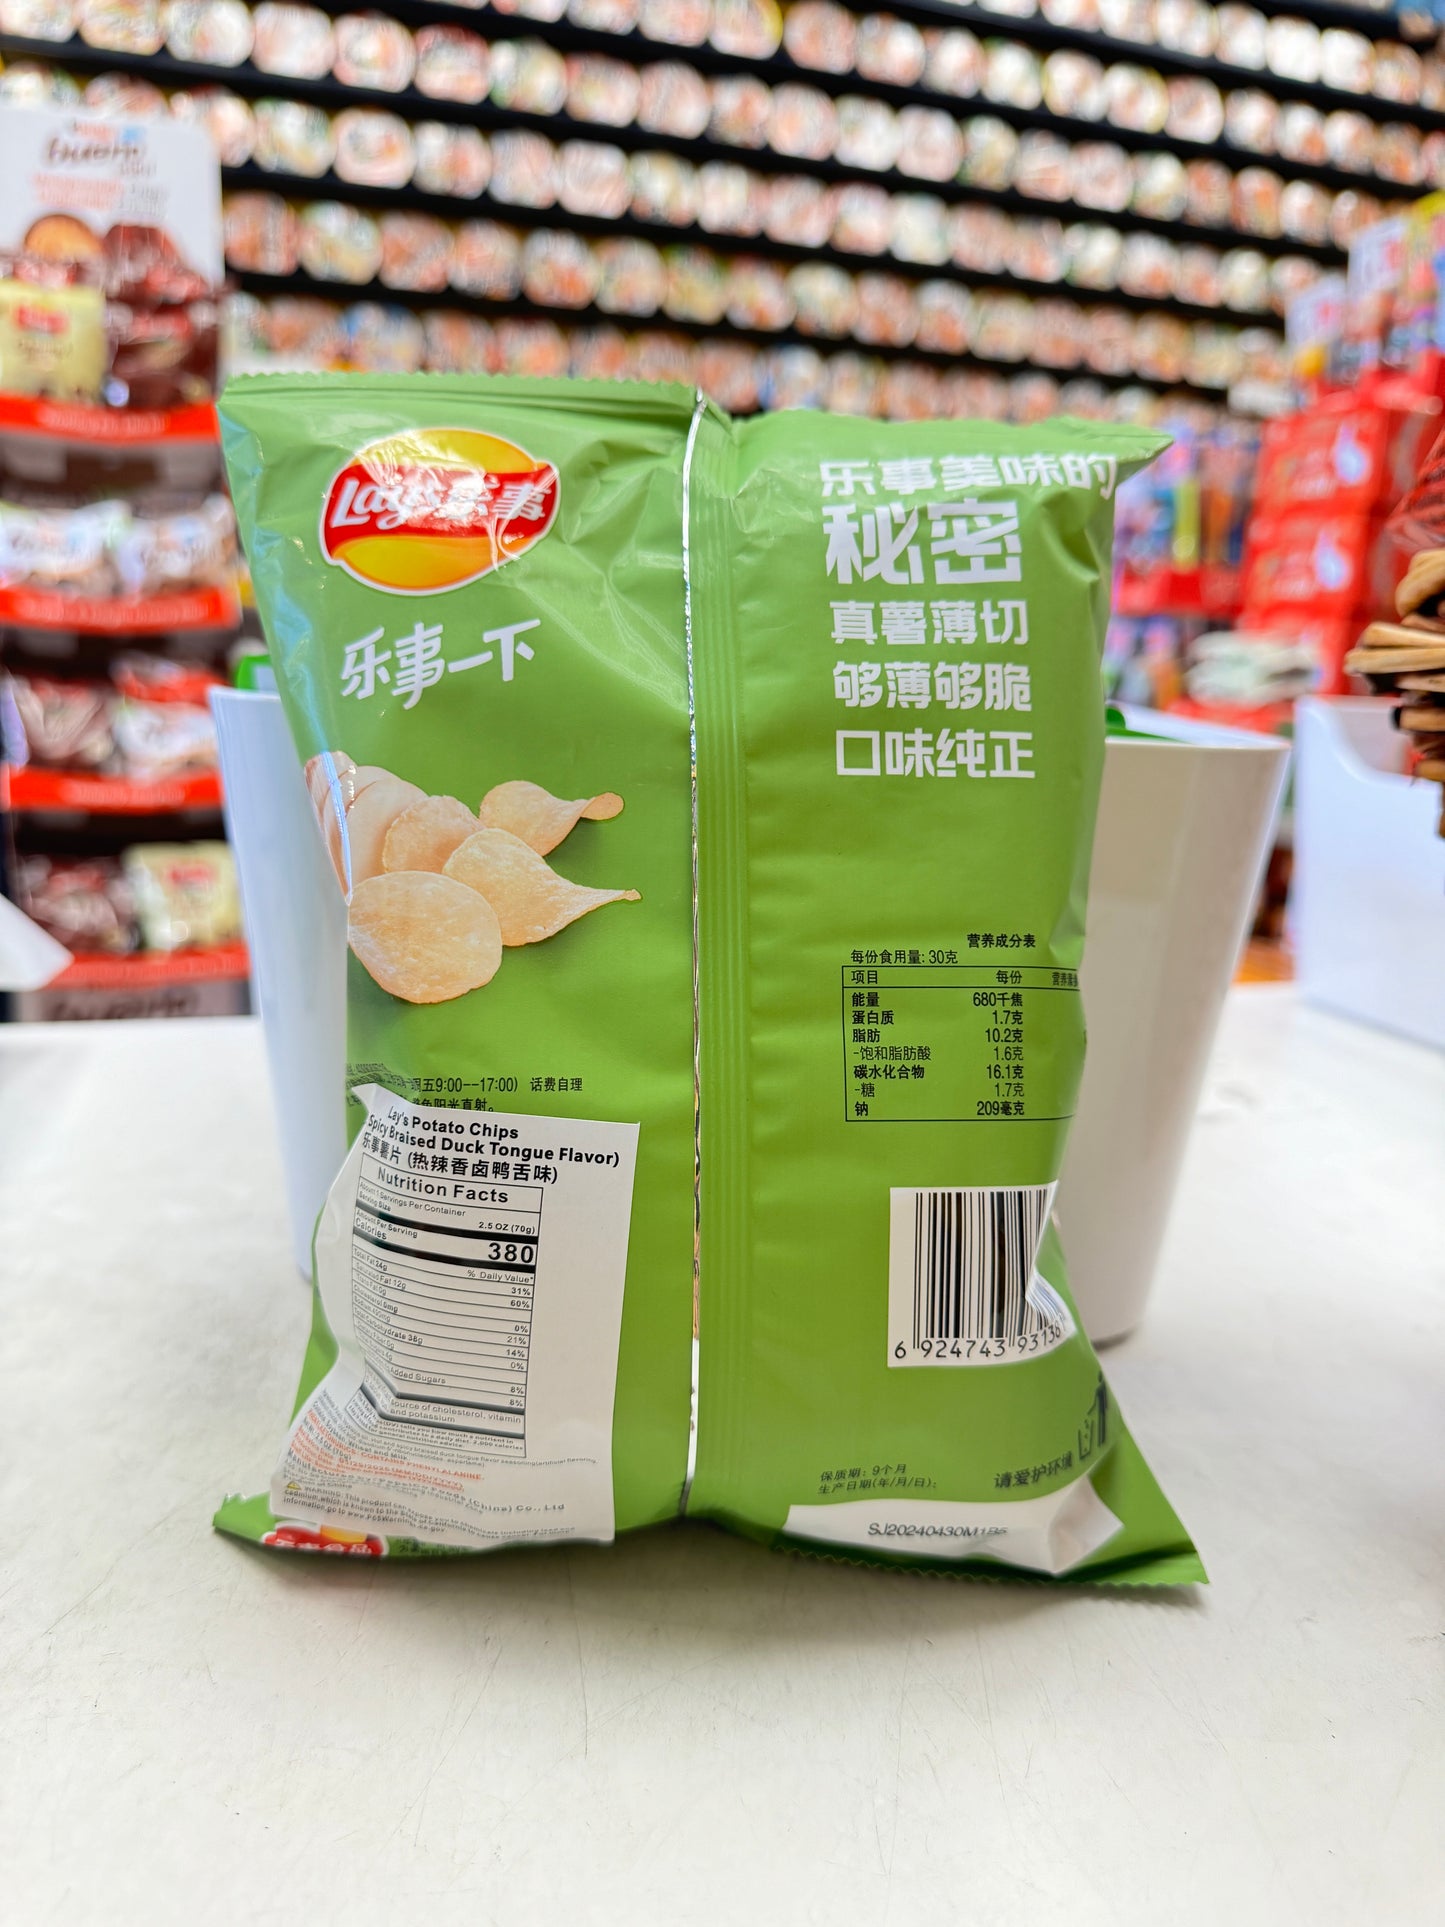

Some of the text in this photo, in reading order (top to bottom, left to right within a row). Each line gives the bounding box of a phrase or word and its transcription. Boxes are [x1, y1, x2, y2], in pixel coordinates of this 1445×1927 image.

[819, 452, 1118, 500] 乐事美味的
[822, 497, 1023, 585] 秘密
[829, 600, 1028, 645] 真薯薄切
[339, 618, 541, 711] 乐事一下
[833, 661, 1032, 711] 够薄够脆
[835, 727, 1035, 778] 口味纯正
[967, 933, 1036, 949] 营养成分表
[851, 970, 879, 985] 项目
[996, 970, 1022, 985] 每份
[852, 992, 1023, 1008] 能量 680千焦
[851, 1010, 1023, 1025] 蛋白质 1.7克
[852, 1028, 1024, 1043] 脂肪 10.2克
[993, 1046, 1024, 1061] 1.6克
[853, 1064, 1024, 1080] 碳水化合物 16.1克
[530, 1077, 583, 1092] 话费自理
[995, 1082, 1025, 1097] 1.7克
[854, 1101, 1025, 1116] 钠 209毫克
[388, 1105, 519, 1139] Lay's Potato Chips
[368, 1114, 620, 1167] Spicy Braised Duck Tongue Flavor)
[362, 1131, 558, 1184] 乐事薯片 (热辣香卤鸭舌味)
[378, 1166, 509, 1203] Nutrition Facts
[409, 1200, 423, 1210] Per
[424, 1203, 467, 1217] Container
[388, 1223, 418, 1239] Serving
[479, 1221, 494, 1230] 2.5
[495, 1223, 509, 1231] OZ
[510, 1223, 536, 1235] (70g)
[355, 1217, 535, 1264] Calories 380
[480, 1270, 502, 1284] Daily
[511, 1287, 531, 1296] 31%
[510, 1300, 531, 1309] 60%
[514, 1324, 529, 1333] 0%
[507, 1335, 527, 1345] 21%
[506, 1349, 526, 1358] 14%
[894, 1340, 907, 1359] 6
[920, 1338, 1006, 1359] 924743
[510, 1361, 525, 1371] 0%
[415, 1373, 447, 1385] Sugars
[510, 1385, 525, 1395] 8%
[509, 1398, 524, 1408] 8%
[390, 1408, 456, 1423] and potassium
[421, 1404, 432, 1412] of
[432, 1405, 486, 1420] cholesterol,
[487, 1412, 521, 1424] vitamin
[993, 1451, 1074, 1490] 请爱护环境
[544, 1503, 565, 1511] Ltd
